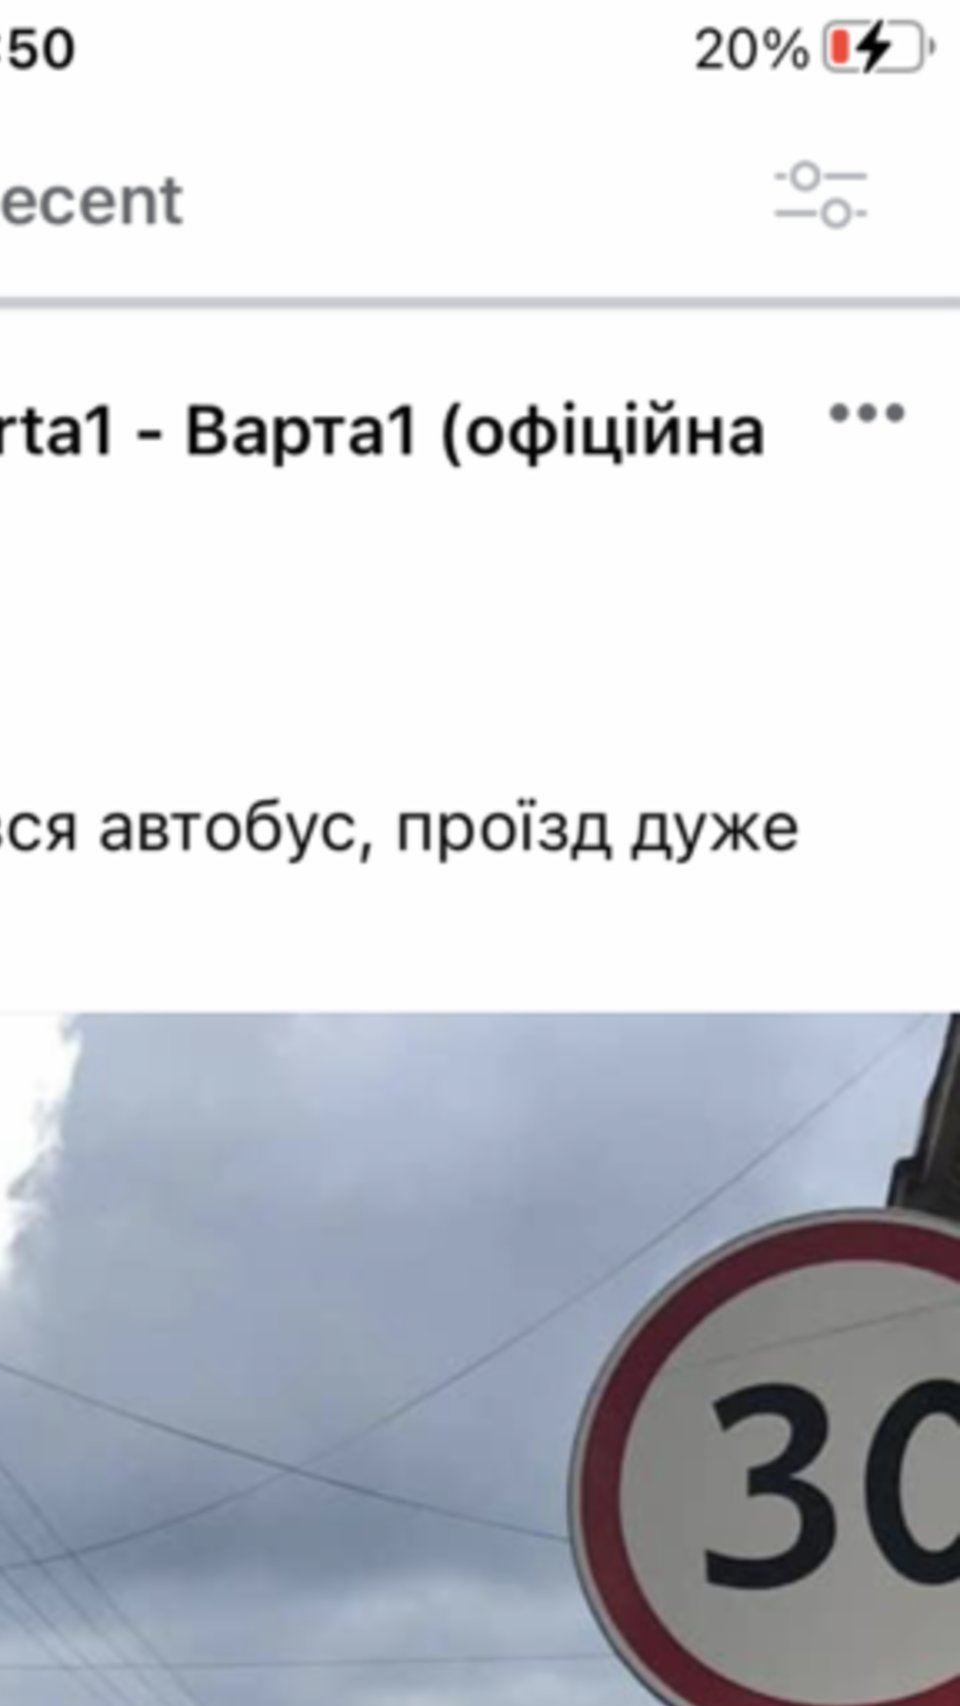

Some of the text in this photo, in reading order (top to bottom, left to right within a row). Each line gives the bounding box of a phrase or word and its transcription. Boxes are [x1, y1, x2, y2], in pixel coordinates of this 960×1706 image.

[695, 26, 810, 71] 20%
[135, 428, 163, 442] -
[187, 403, 413, 468] Варта1
[442, 399, 764, 468] (офіційна
[99, 797, 373, 865] автобус,
[398, 797, 613, 864] проїзд
[631, 811, 799, 865] дуже
[705, 1379, 960, 1589] 30
